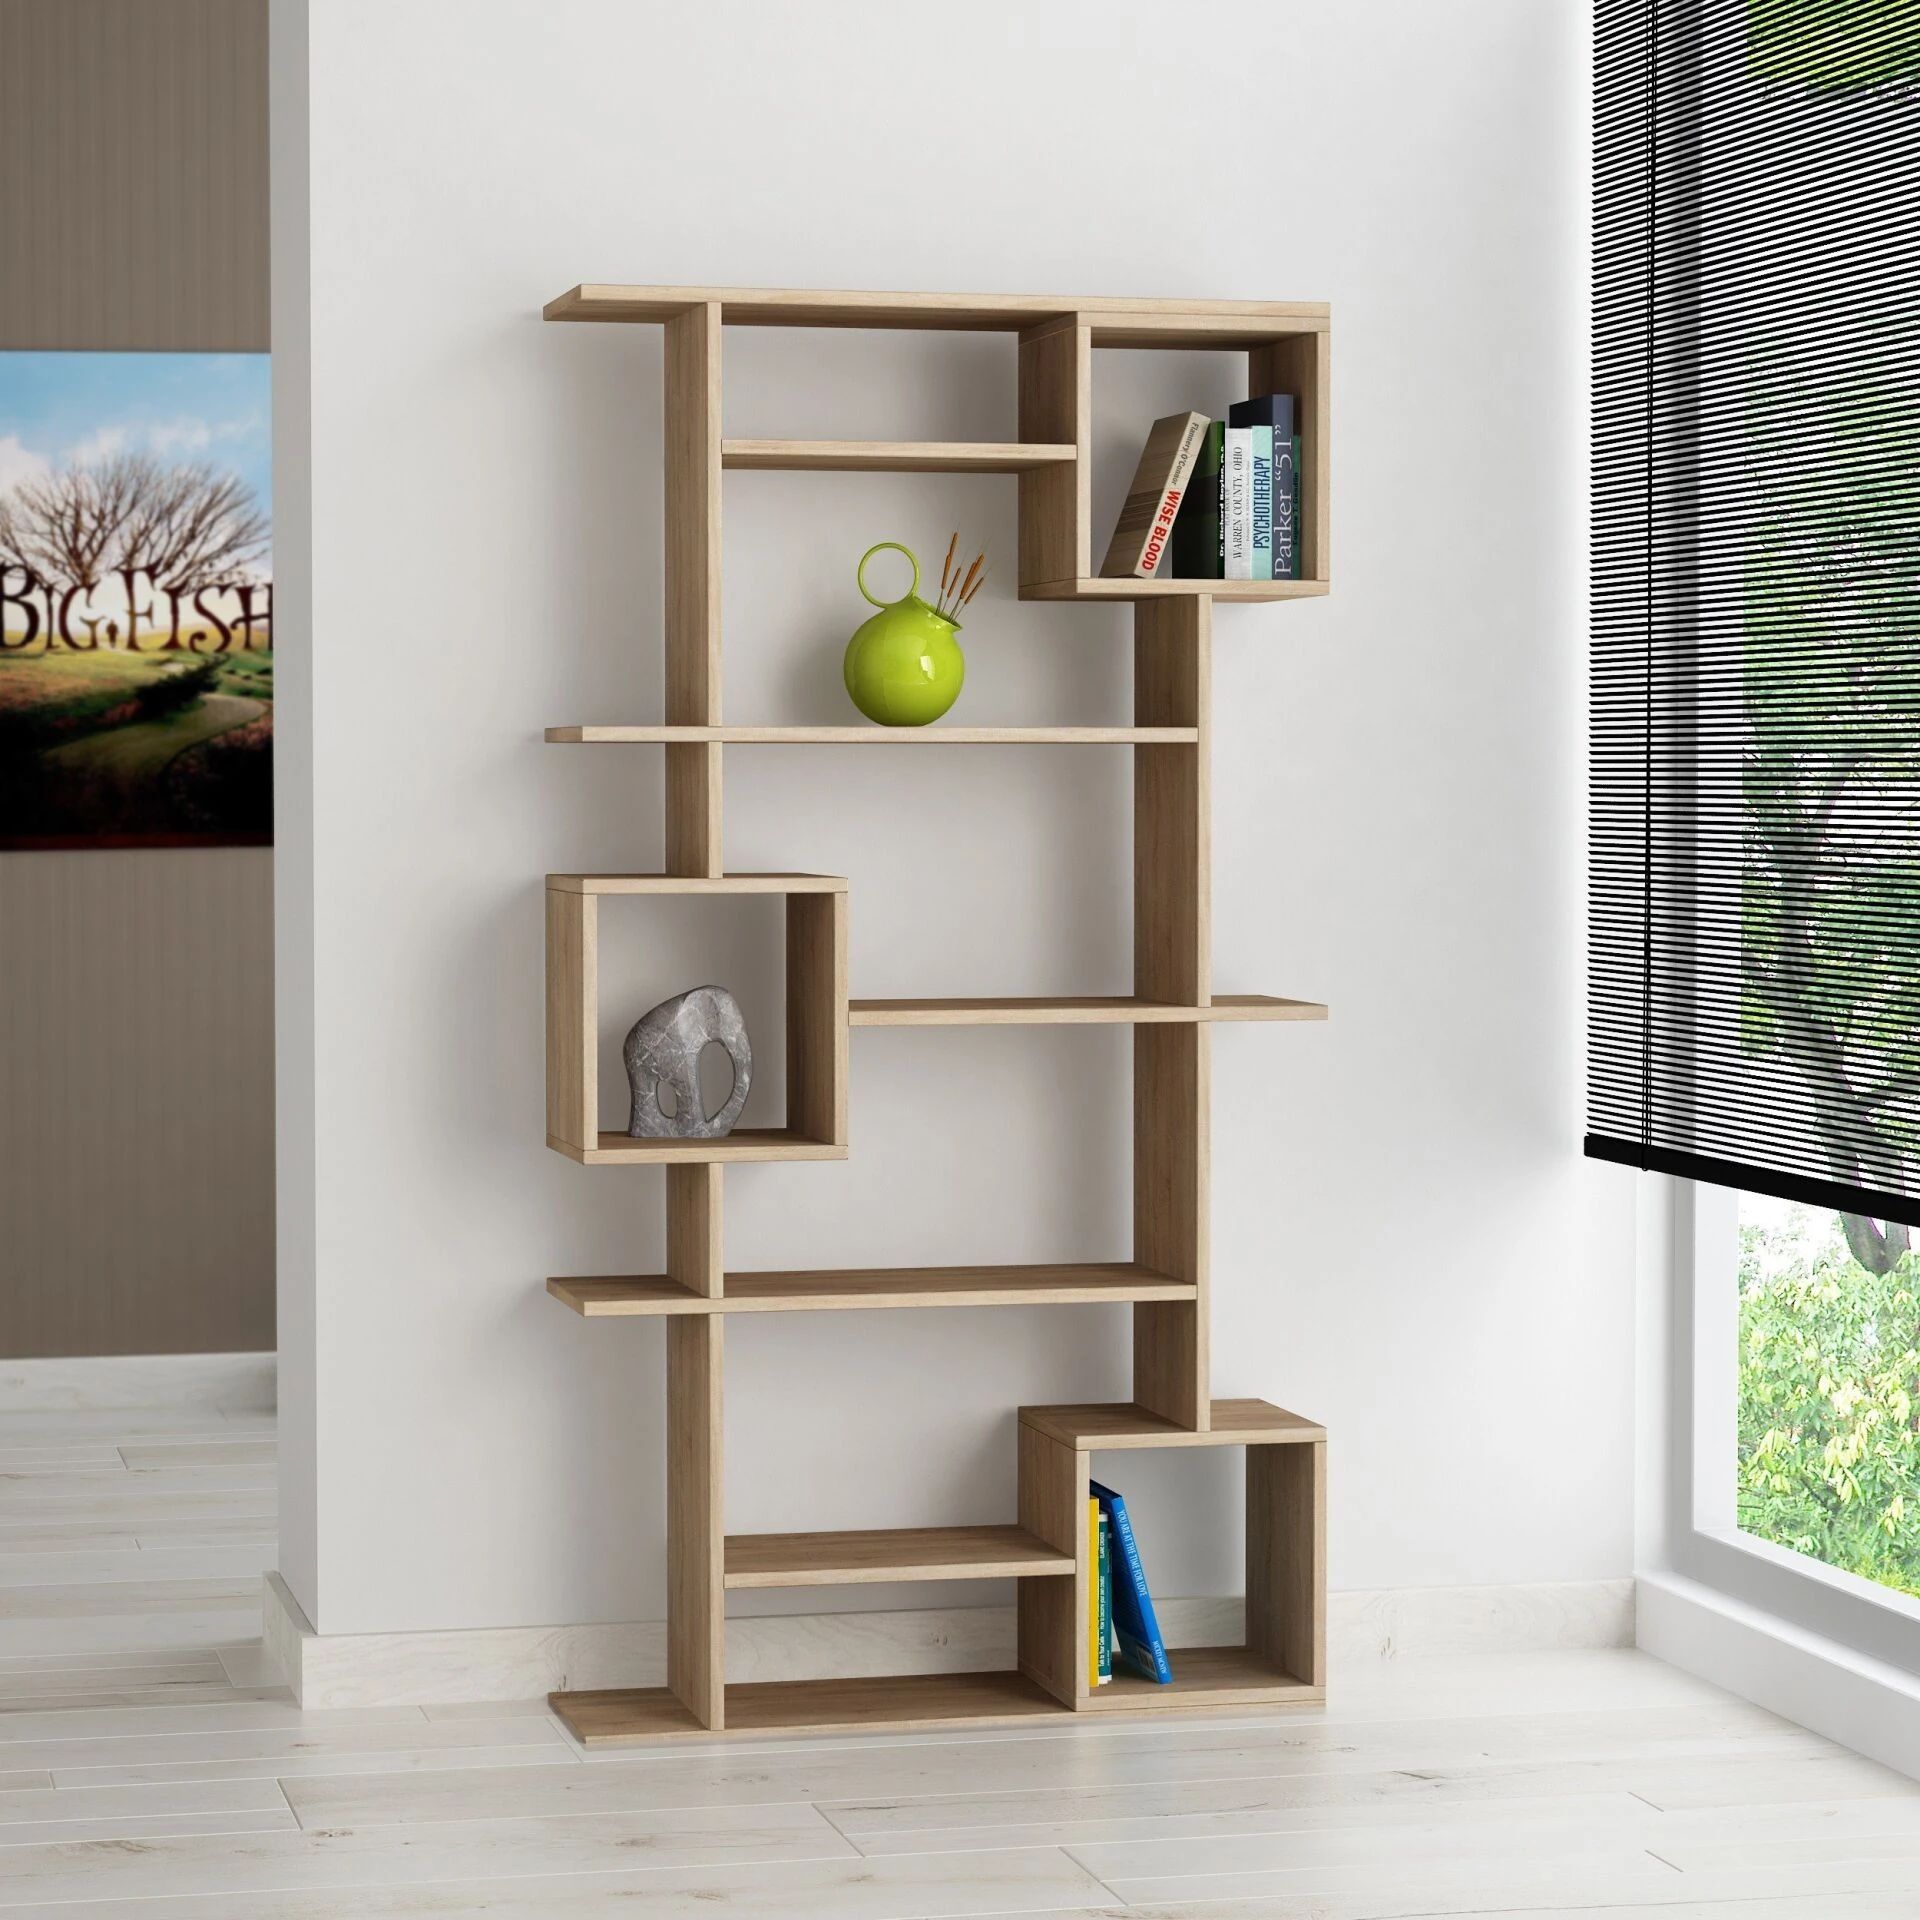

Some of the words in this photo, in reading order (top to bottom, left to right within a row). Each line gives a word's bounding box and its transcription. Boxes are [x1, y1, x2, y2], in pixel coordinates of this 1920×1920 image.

[1182, 422, 1199, 452] Flannery
[1233, 446, 1243, 470] OHIO
[1158, 490, 1182, 524] WISE
[1233, 474, 1244, 515] COUNTY,
[1253, 456, 1270, 549] PSYCHOTHERAPY
[1142, 526, 1168, 571] BLOOD
[1233, 519, 1242, 559] WARREN
[1274, 490, 1292, 575] Parker
[0, 561, 103, 650] BIG
